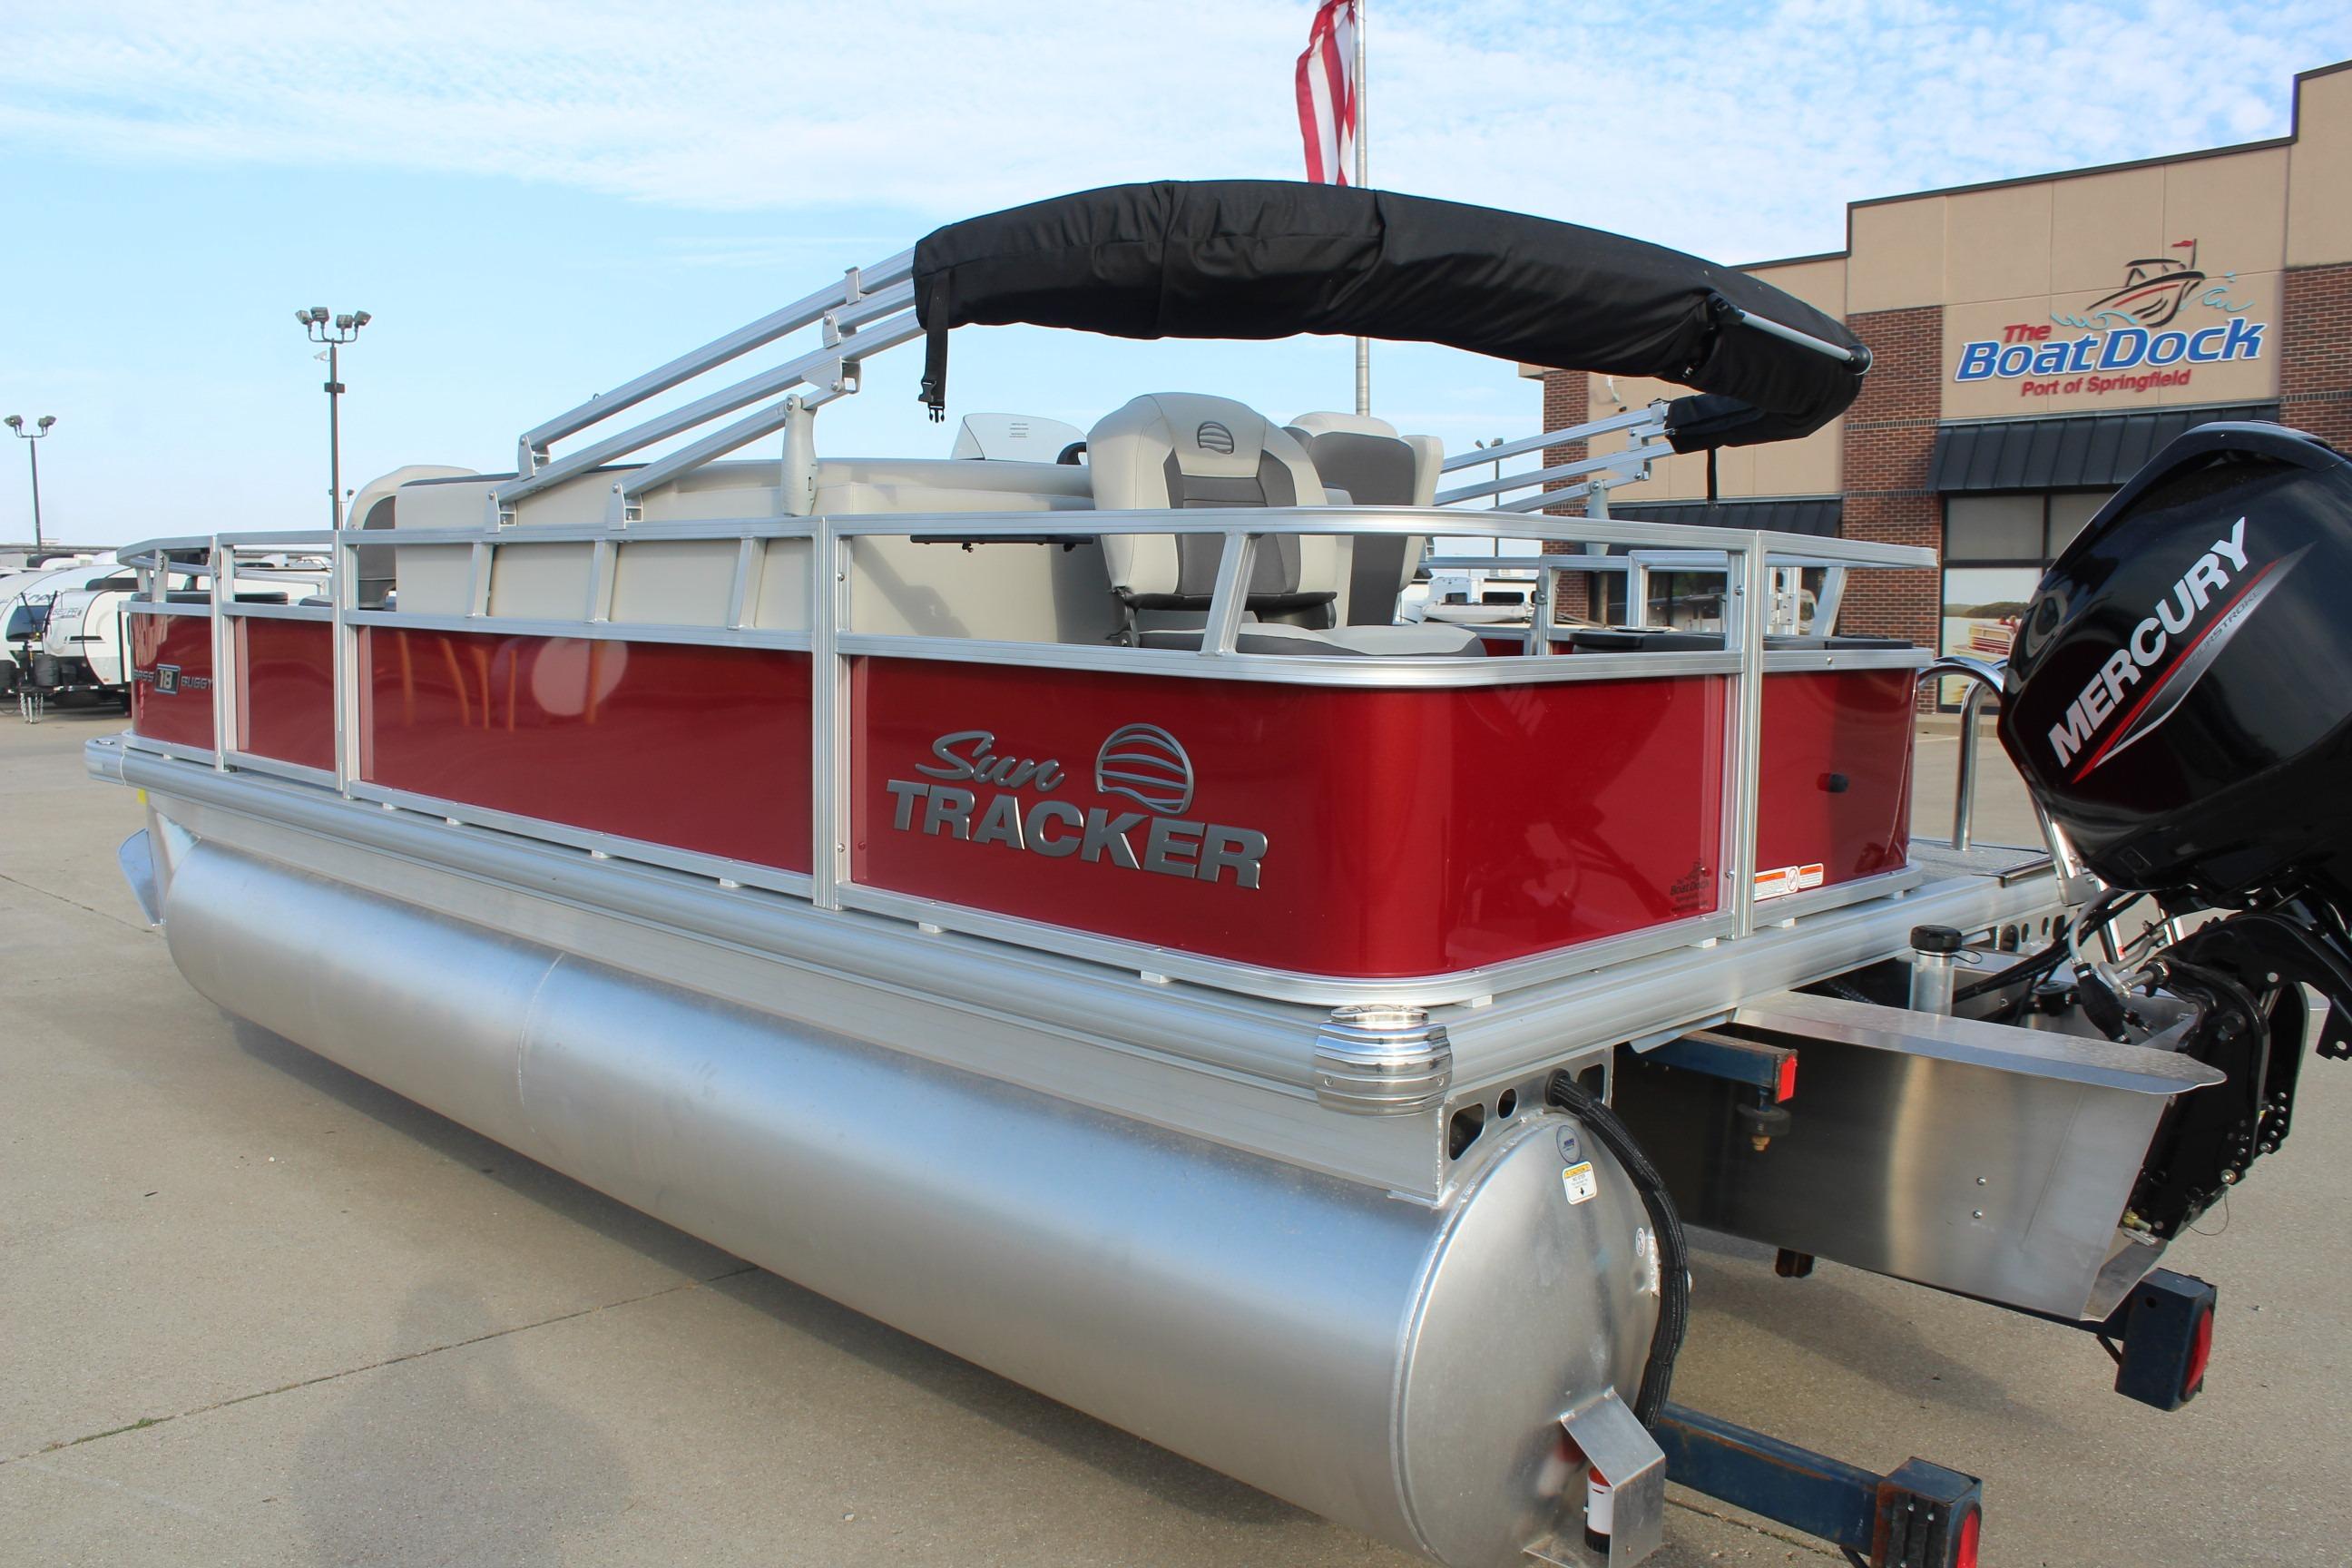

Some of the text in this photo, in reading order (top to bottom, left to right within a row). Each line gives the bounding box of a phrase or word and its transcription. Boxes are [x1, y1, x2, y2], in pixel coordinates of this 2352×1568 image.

[2004, 323, 2053, 344] The
[2021, 368, 2192, 397] Port of Springfield
[2048, 515, 2249, 769] MERCURY
[160, 670, 173, 690] 18
[915, 730, 1065, 792] Sun
[887, 779, 1269, 890] TRACKER
